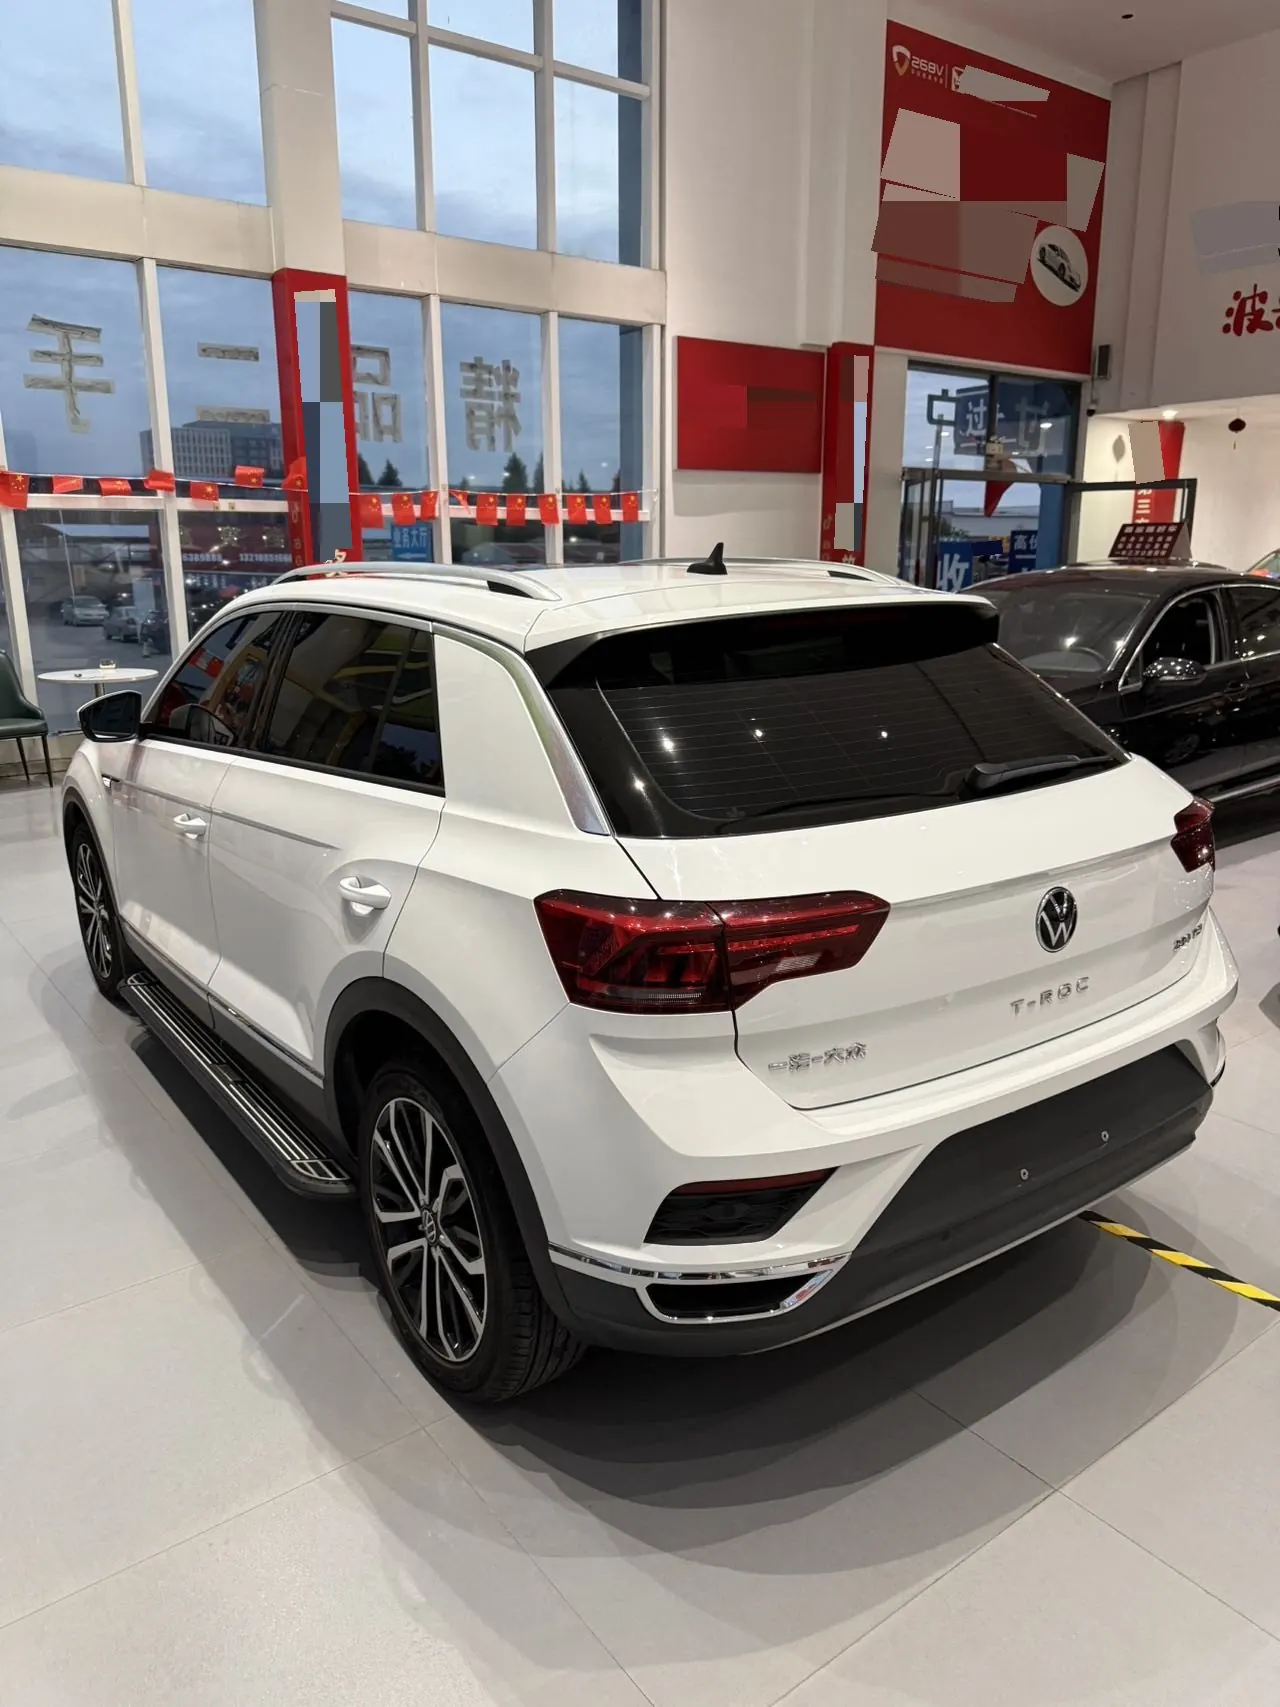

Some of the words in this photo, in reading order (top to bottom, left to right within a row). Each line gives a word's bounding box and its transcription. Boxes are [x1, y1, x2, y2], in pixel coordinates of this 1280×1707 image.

[911, 55, 944, 76] 268V
[393, 527, 428, 548] 业务大厅
[937, 553, 969, 592] 收
[1010, 977, 1089, 1016] T-ROC
[768, 1042, 867, 1072] 一汽-大众
